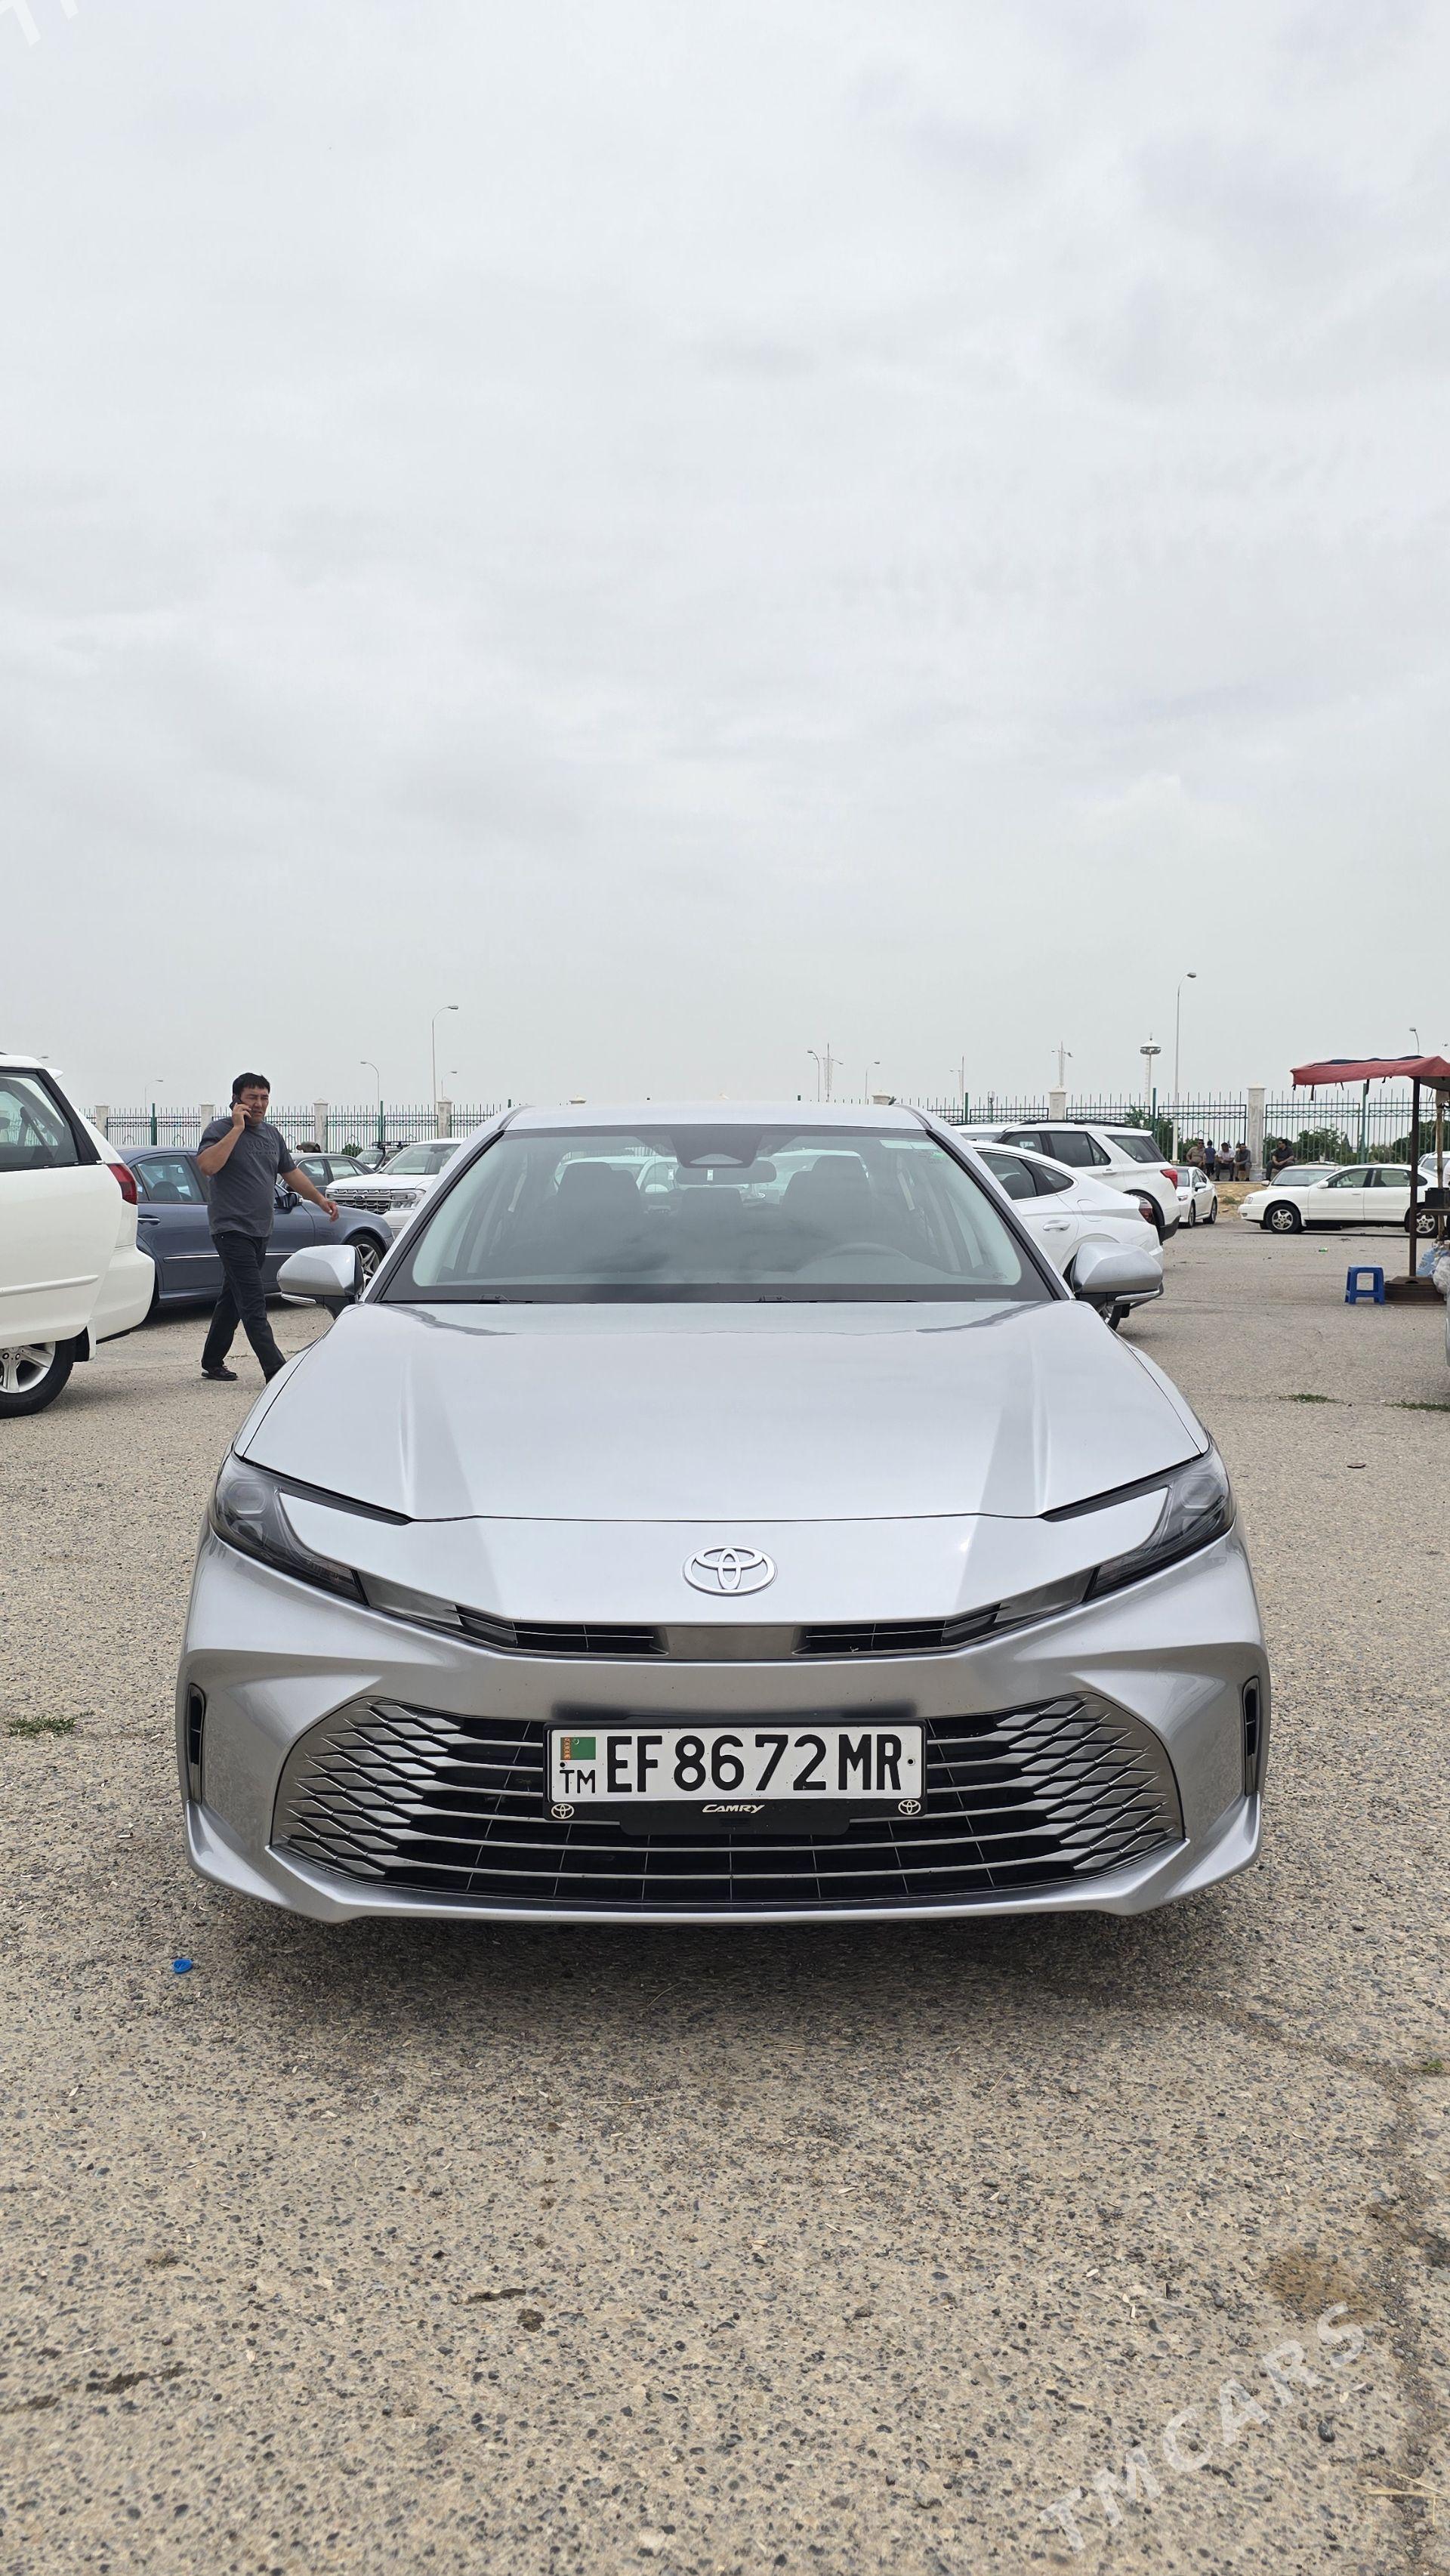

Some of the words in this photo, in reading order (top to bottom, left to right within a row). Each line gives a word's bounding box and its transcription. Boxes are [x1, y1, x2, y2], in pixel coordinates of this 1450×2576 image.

[247, 1140, 276, 1151] BOSS
[559, 1769, 596, 1794] TM
[702, 1804, 766, 1814] CAMRY
